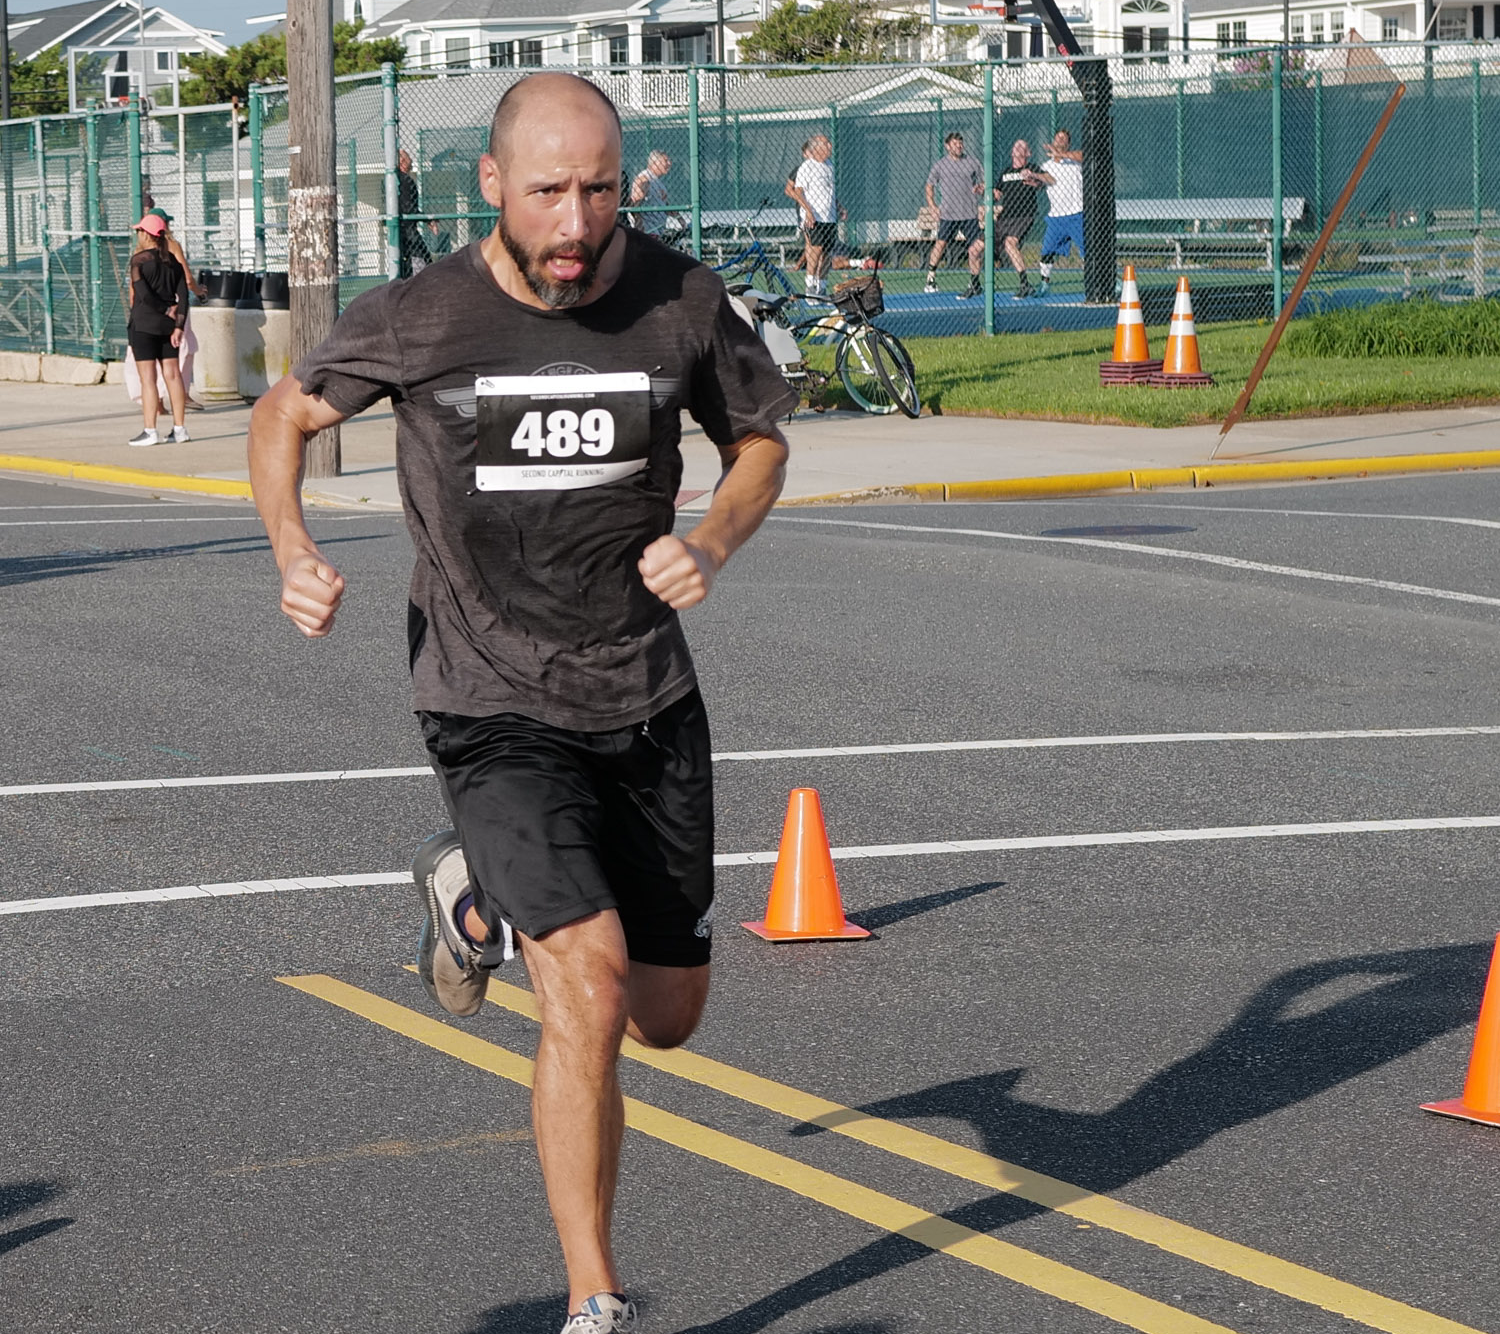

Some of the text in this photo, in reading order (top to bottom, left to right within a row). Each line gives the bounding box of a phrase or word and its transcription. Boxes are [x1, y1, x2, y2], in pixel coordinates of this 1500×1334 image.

[511, 409, 615, 457] 489
[521, 469, 546, 478] SECOND
[575, 467, 604, 477] RUNNING
